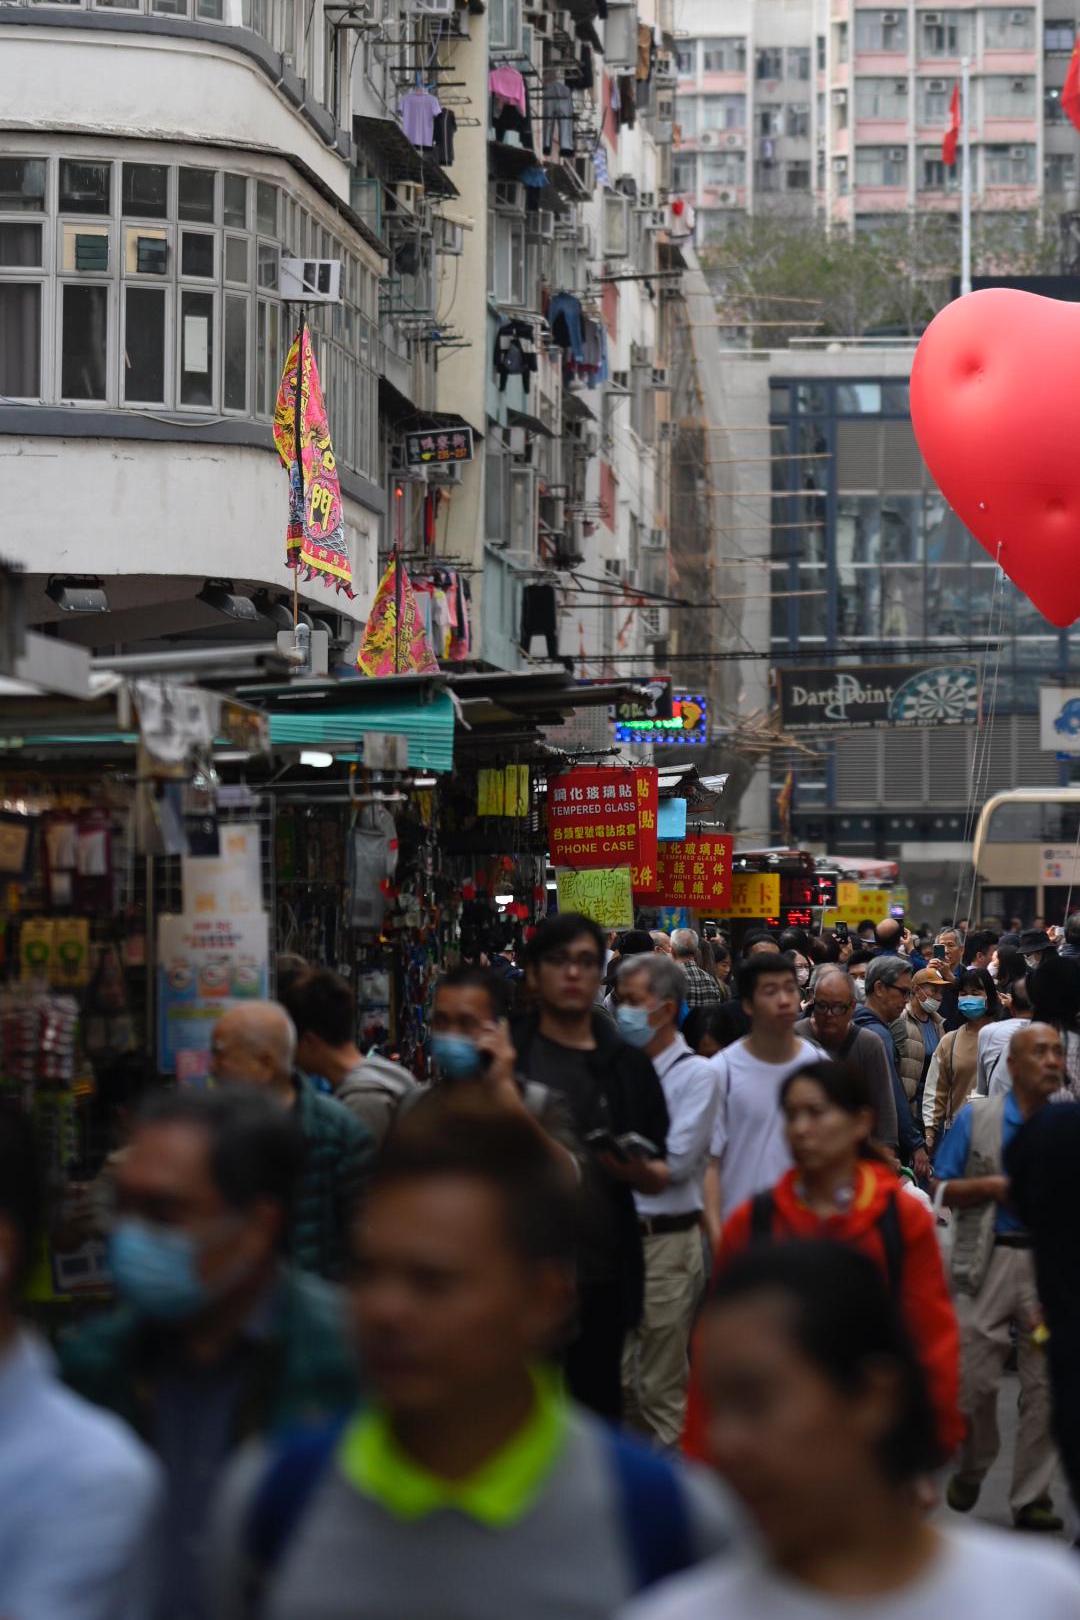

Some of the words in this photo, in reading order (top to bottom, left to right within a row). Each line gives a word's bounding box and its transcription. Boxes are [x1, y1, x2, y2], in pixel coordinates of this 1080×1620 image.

[553, 784, 632, 802] 鋼化玻璃貼
[552, 803, 601, 816] TEMPERED
[604, 801, 636, 813] GLASS
[553, 823, 637, 841] 各類型號電話皮套
[556, 842, 598, 855] PHONE
[602, 840, 635, 852] CASE
[665, 892, 687, 900] PHONE
